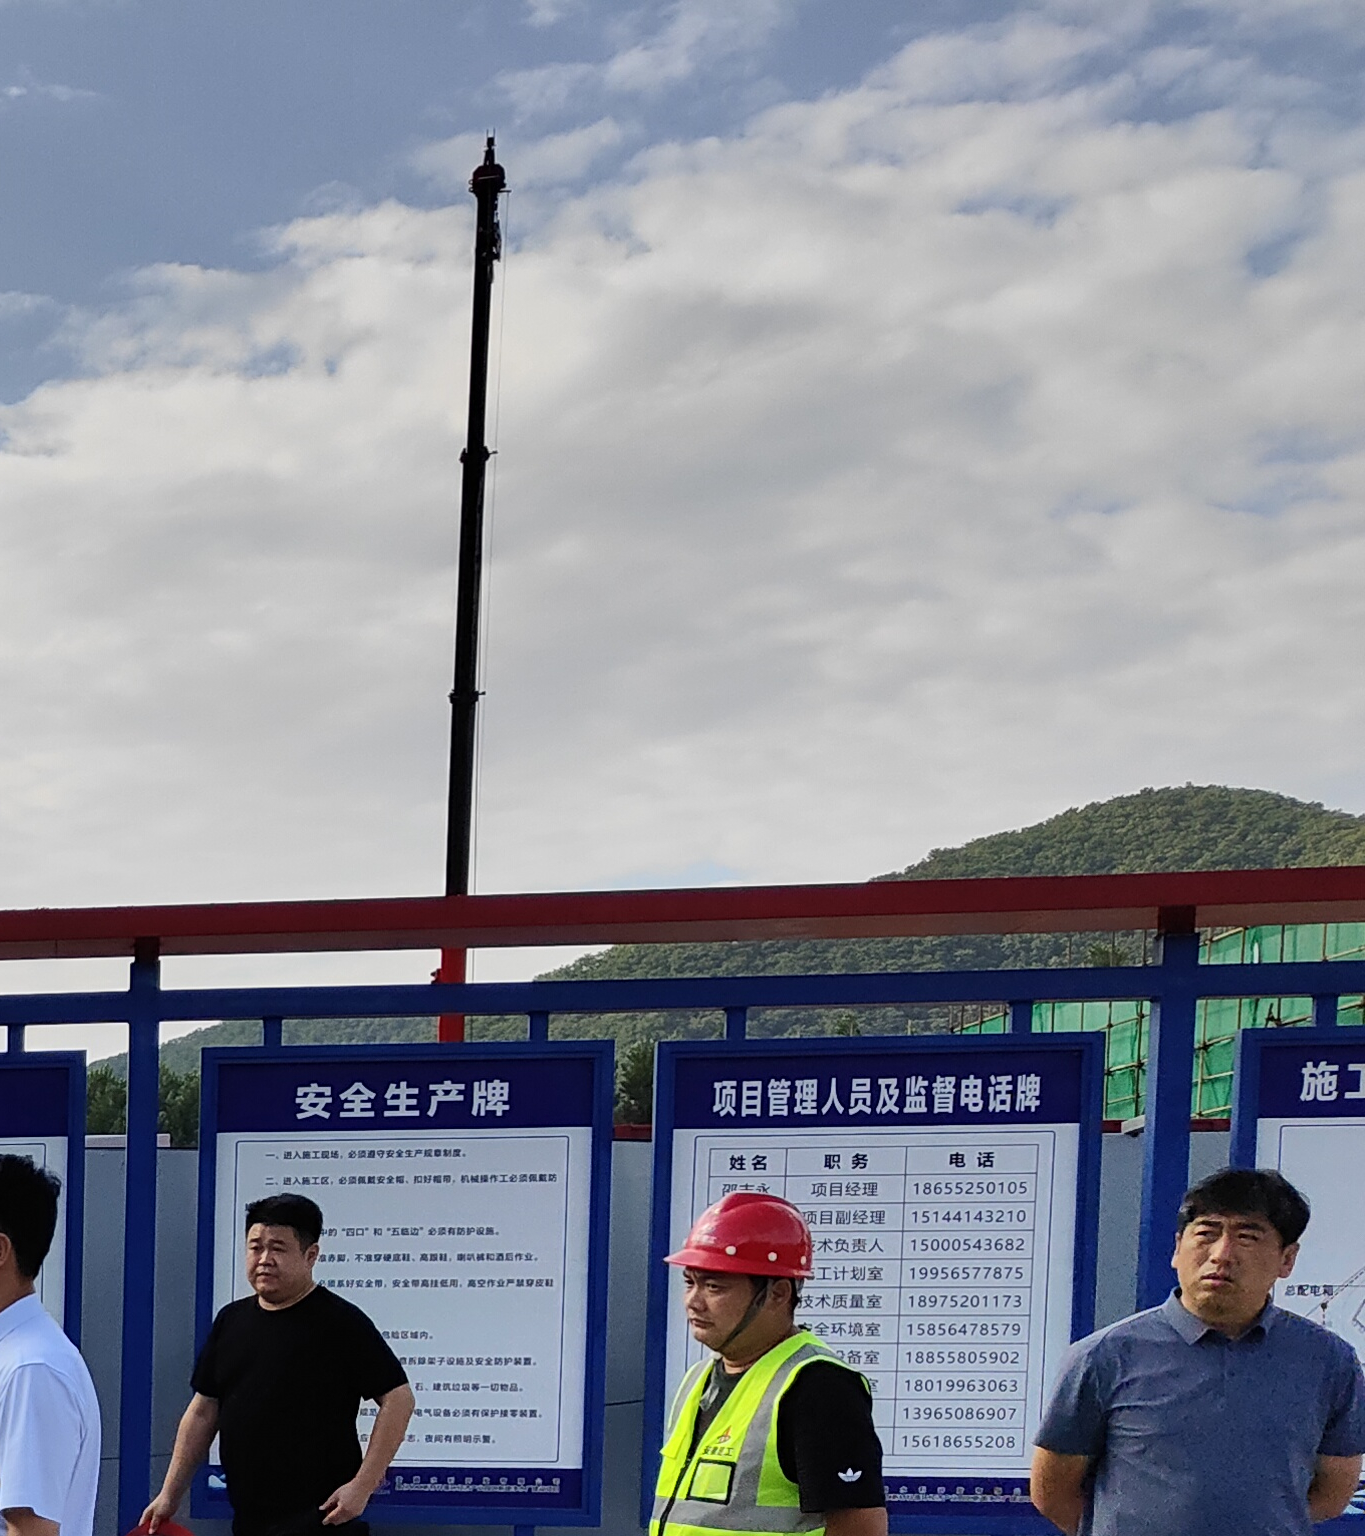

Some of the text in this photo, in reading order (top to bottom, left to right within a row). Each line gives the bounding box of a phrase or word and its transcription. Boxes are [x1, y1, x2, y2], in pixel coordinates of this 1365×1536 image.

[294, 1078, 511, 1120] 安全生产牌
[712, 1073, 1042, 1118] 项目管理人员及监督电话牌
[729, 1150, 996, 1171] 姓名 职务 电话
[810, 1181, 879, 1197] 项目经理
[912, 1181, 1029, 1196] 18655250105
[803, 1209, 1027, 1225] 项目副经理 15144143210
[909, 1237, 1026, 1253] 15000543682
[812, 1265, 1025, 1281] 工计划室 19956577875
[798, 1293, 1023, 1309] 技术质量室 18975201173
[905, 1322, 1022, 1337] 15856478579
[904, 1350, 1020, 1365] 18855805902
[904, 1378, 1019, 1393] 18019963063
[902, 1406, 1018, 1421] 13965086907
[900, 1434, 1016, 1449] 15618655208
